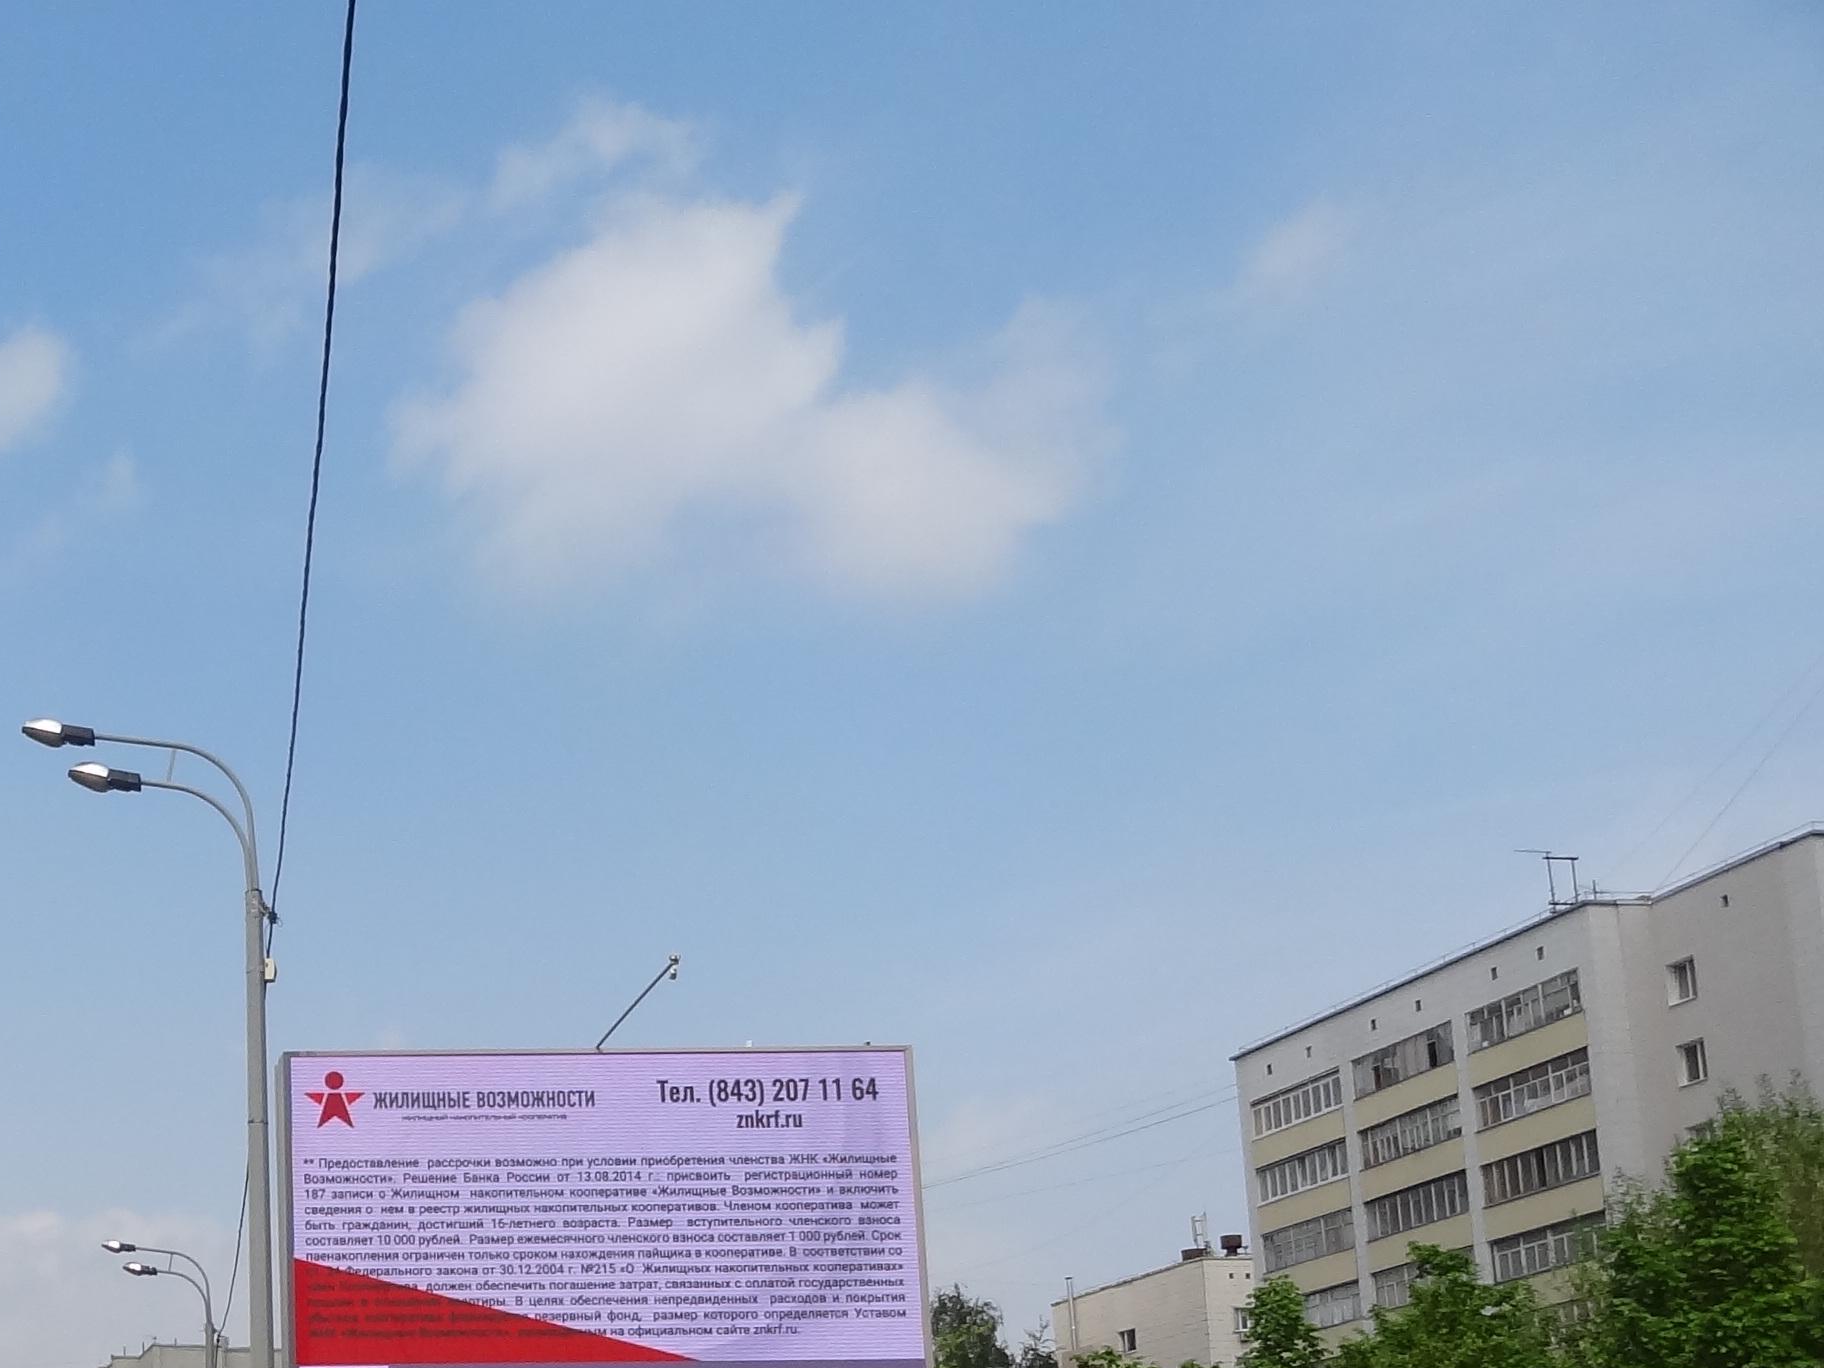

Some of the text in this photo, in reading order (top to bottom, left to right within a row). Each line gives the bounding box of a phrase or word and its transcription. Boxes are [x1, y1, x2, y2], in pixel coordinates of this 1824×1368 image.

[373, 1090, 596, 1110] ЖИЛИЩНЫЕ ВОЗМОЖНОСТИ
[656, 1077, 879, 1107] Тел. (843) 207 11 64
[737, 1110, 803, 1128] znkrf.ru
[318, 1156, 420, 1170] Предоставление
[427, 1158, 491, 1169] рассрочки
[494, 1157, 558, 1166] возможно
[561, 1157, 584, 1168] при
[586, 1156, 637, 1168] условии
[640, 1154, 725, 1167] приобретения
[728, 1155, 785, 1164] членства
[788, 1153, 819, 1164] ЖНК
[402, 1171, 458, 1182] Решение
[463, 1171, 500, 1182] Банка
[506, 1170, 551, 1181] России
[556, 1172, 571, 1181] от
[577, 1170, 642, 1181] 13.08.2014
[666, 1171, 731, 1183] присвоить
[744, 1168, 853, 1182] регистрационный
[859, 1170, 898, 1181] номер
[304, 1187, 326, 1198] 187
[330, 1189, 374, 1198] записи
[378, 1189, 386, 1198] о
[391, 1186, 460, 1200] Жилищном
[469, 1188, 564, 1197] накопительном
[569, 1187, 648, 1199] кооперативе
[826, 1186, 834, 1195] и
[839, 1186, 899, 1195] включить
[304, 1205, 362, 1216] сведения
[365, 1205, 373, 1214] о
[380, 1205, 404, 1213] нем
[407, 1205, 415, 1213] в
[419, 1205, 460, 1216] реестр
[463, 1204, 530, 1215] жилищных
[533, 1203, 628, 1212] накопительных
[723, 1200, 772, 1211] Членом
[775, 1202, 853, 1213] кооператива
[860, 1202, 900, 1210] может
[304, 1218, 336, 1229] быть
[417, 1217, 484, 1231] достигший
[491, 1217, 556, 1228] 16-летнего
[627, 1216, 673, 1230] Размер
[686, 1218, 783, 1229] вступительного
[788, 1217, 852, 1226] членского
[857, 1217, 901, 1225] взноса
[304, 1236, 374, 1245] составляет
[377, 1233, 391, 1244] 10
[393, 1233, 416, 1244] 000
[468, 1233, 515, 1246] Размер
[516, 1234, 605, 1243] ежемесячного
[607, 1234, 670, 1243] членского
[672, 1233, 715, 1242] взноса
[717, 1233, 787, 1242] составляет
[789, 1231, 795, 1241] 1
[798, 1230, 821, 1241] 000
[871, 1230, 902, 1243] Срок
[305, 1252, 400, 1261] паенакопления
[402, 1251, 465, 1263] ограничен
[468, 1251, 510, 1260] только
[512, 1251, 557, 1262] сроком
[560, 1250, 635, 1261] нахождения
[637, 1247, 692, 1261] пайщика
[694, 1249, 702, 1258] в
[788, 1246, 797, 1257] В
[802, 1248, 885, 1257] соответствии
[887, 1248, 903, 1256] со
[436, 1267, 479, 1275] закона
[482, 1267, 495, 1275] от
[498, 1264, 564, 1275] 30.12.2004
[580, 1263, 616, 1274] №215
[642, 1262, 711, 1276] Жилищных
[714, 1264, 810, 1273] накопительных
[425, 1282, 472, 1294] должен
[475, 1279, 546, 1291] обеспечить
[548, 1281, 616, 1290] погашение
[664, 1280, 731, 1289] связанных
[734, 1280, 742, 1288] с
[744, 1277, 796, 1288] оплатой
[798, 1279, 905, 1290] государственных
[514, 1296, 523, 1306] В
[528, 1298, 564, 1309] целях
[569, 1294, 648, 1306] обеспечения
[653, 1296, 758, 1308] непредвиденных
[769, 1295, 827, 1306] расходов
[832, 1295, 840, 1303] и
[845, 1294, 906, 1306] покрытия
[652, 1311, 698, 1323] размер
[703, 1311, 758, 1322] которого
[763, 1310, 849, 1322] определяется
[854, 1307, 907, 1318] Уставом
[610, 1328, 625, 1336] на
[627, 1325, 713, 1338] официальном
[715, 1324, 751, 1335] сайте
